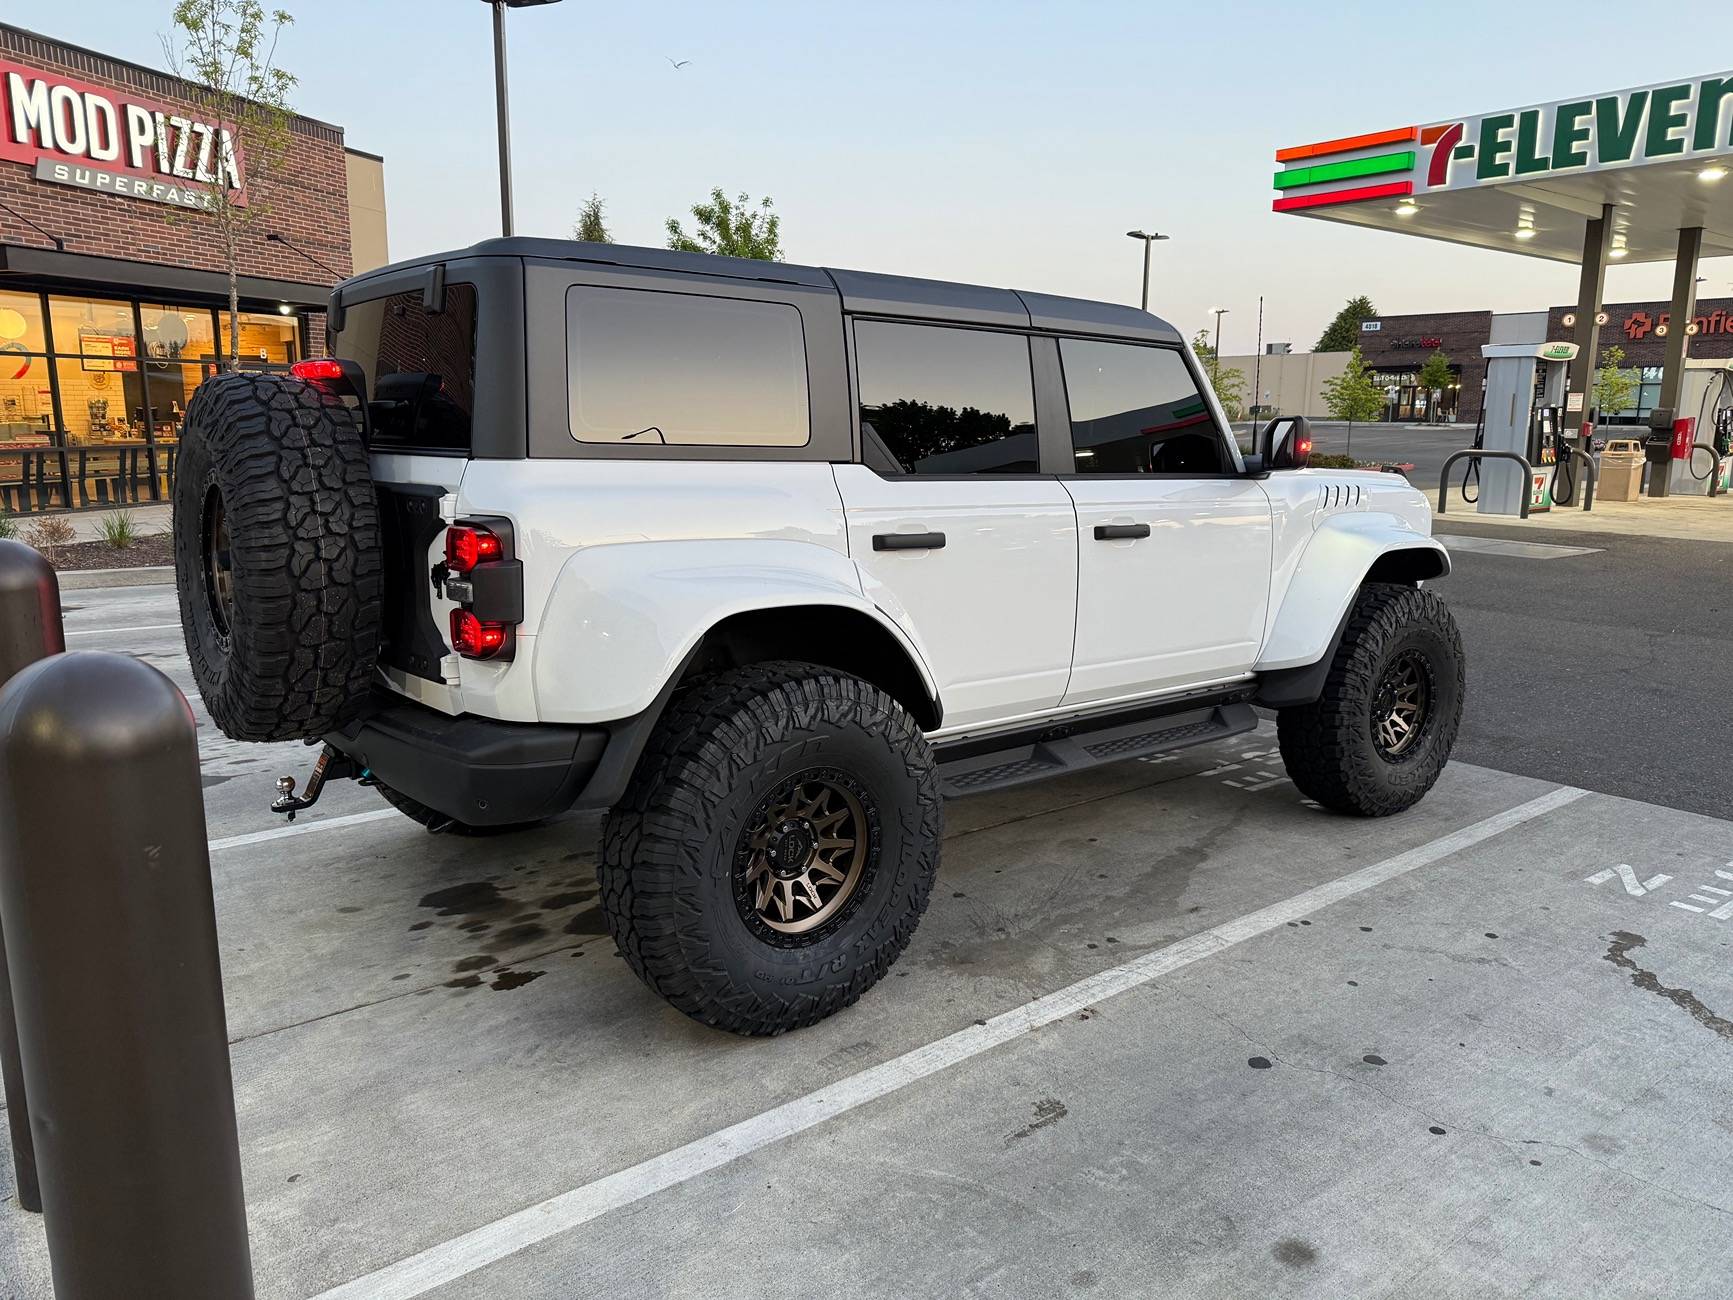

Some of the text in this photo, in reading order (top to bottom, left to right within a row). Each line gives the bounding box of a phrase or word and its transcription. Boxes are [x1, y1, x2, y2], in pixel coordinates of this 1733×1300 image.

[6, 72, 241, 189] MOD PIZZA
[54, 164, 213, 208] SUPERFAST
